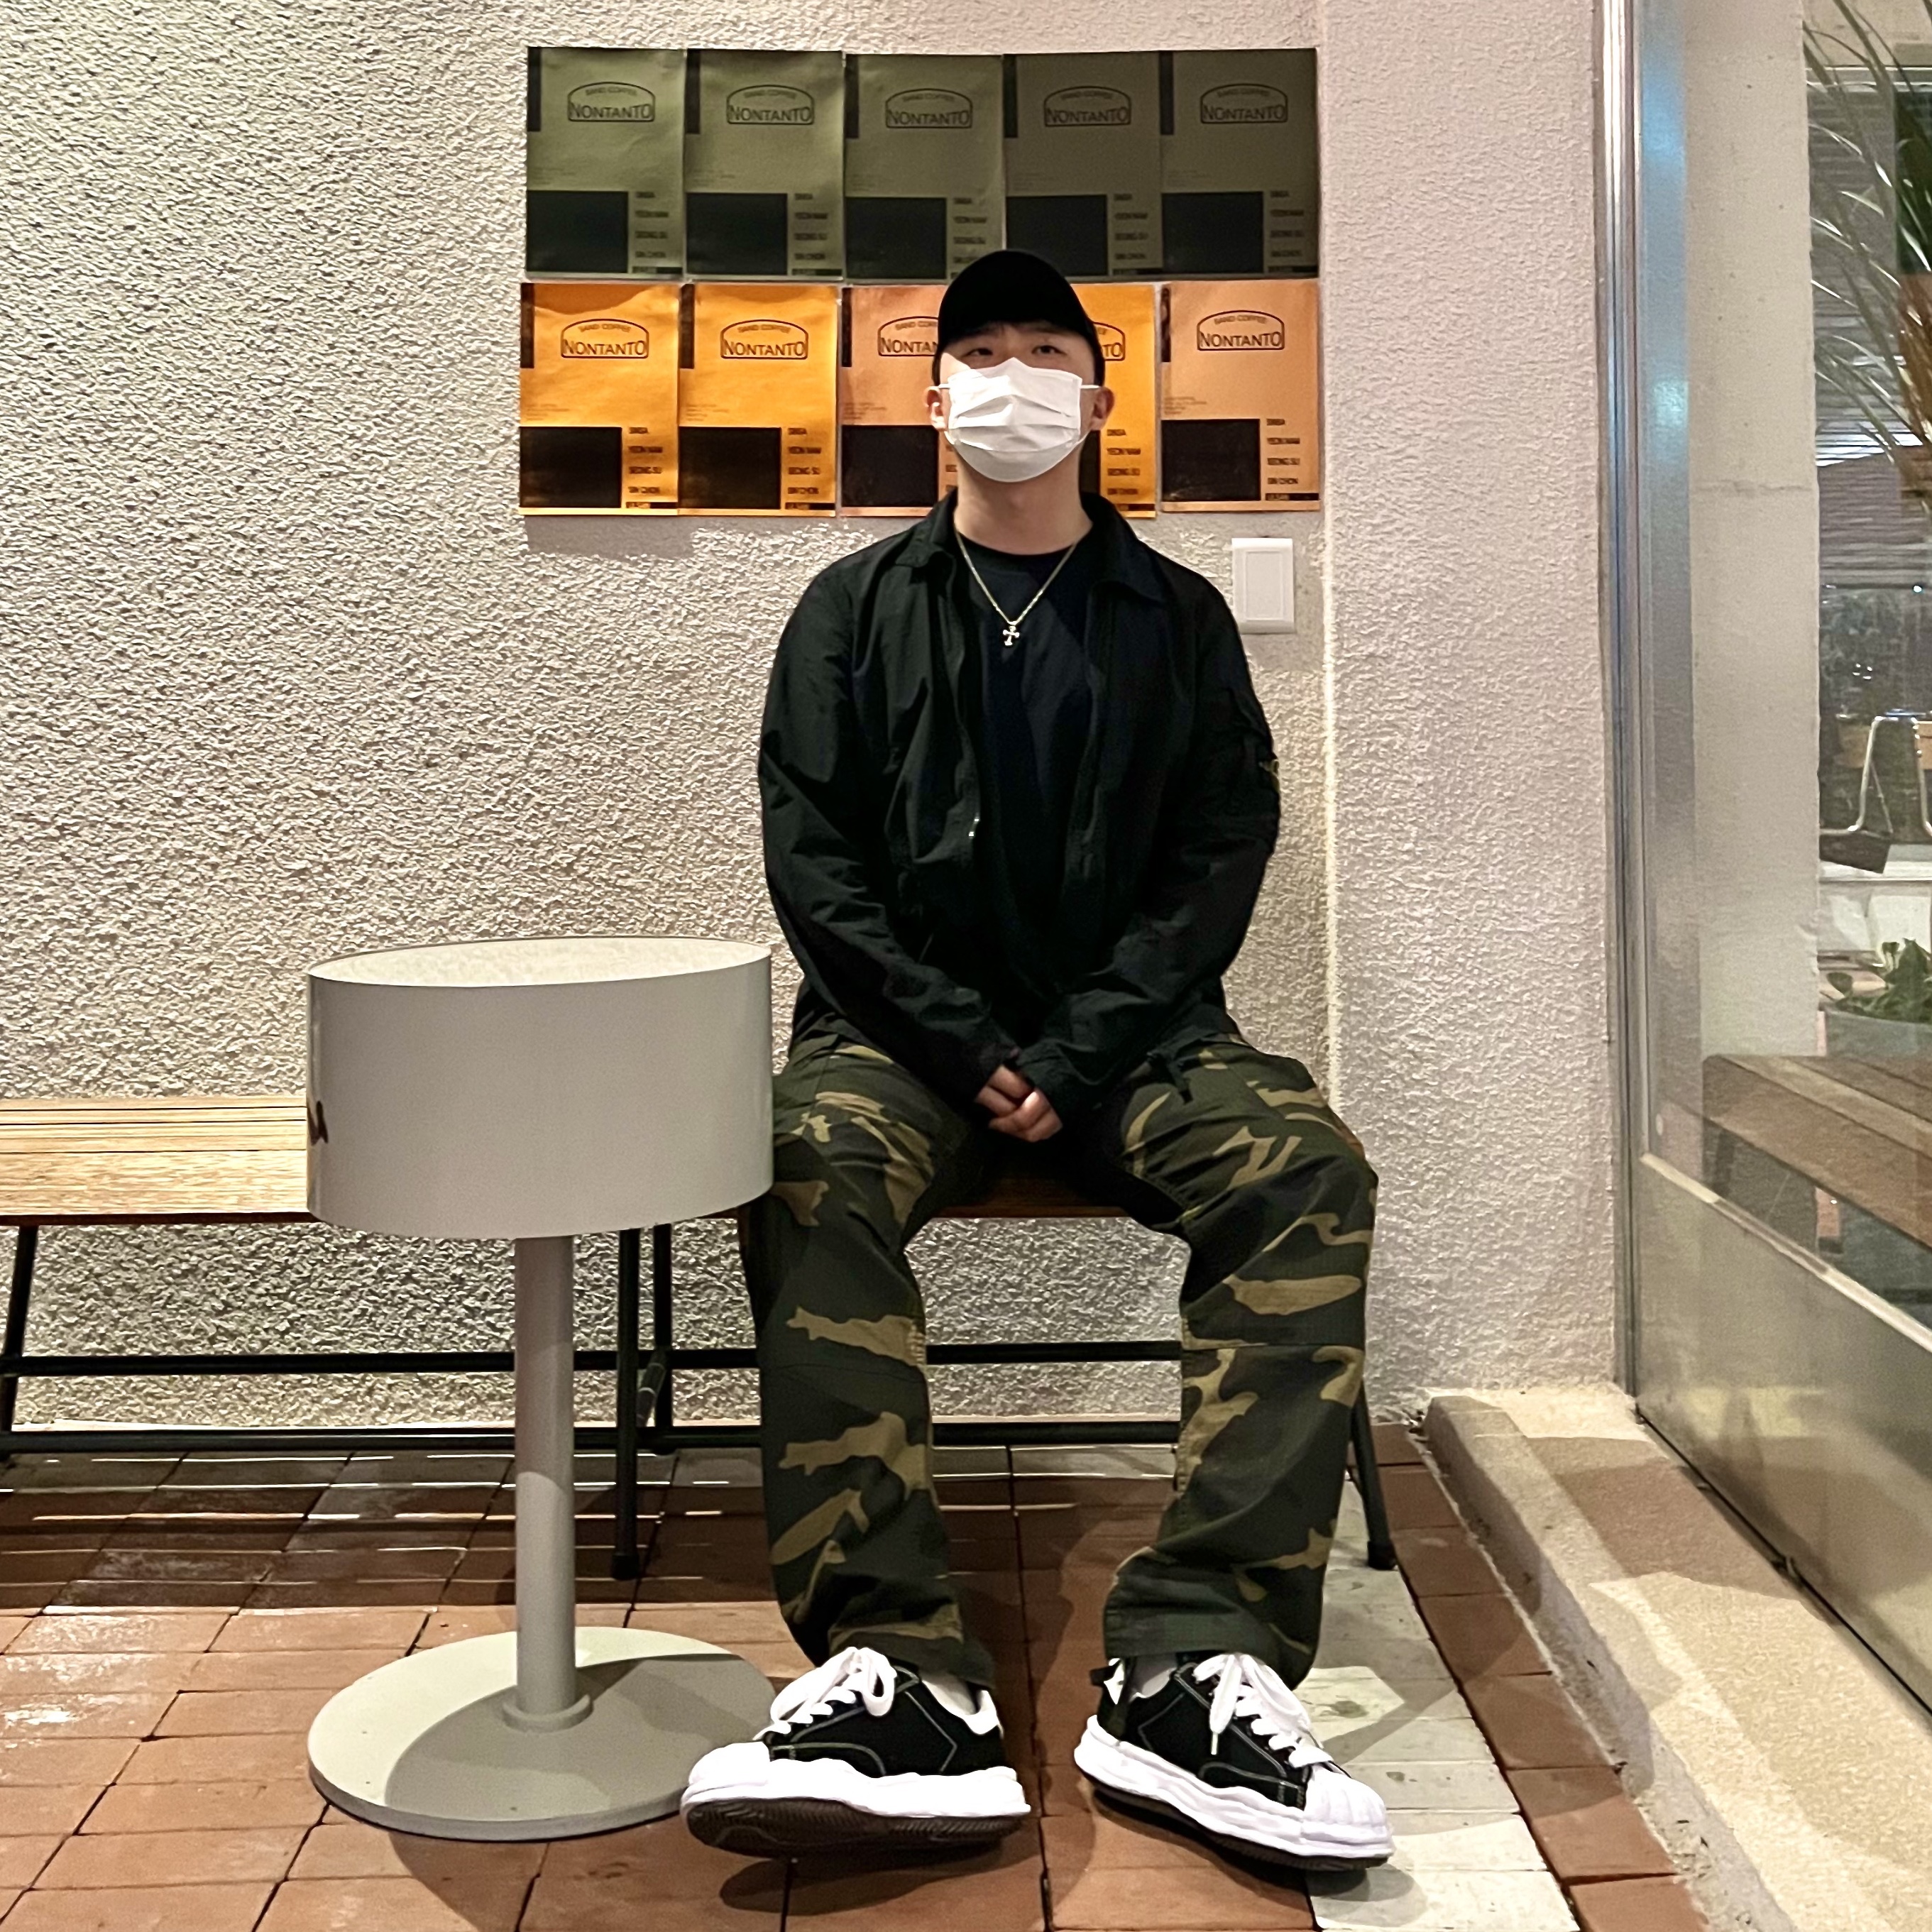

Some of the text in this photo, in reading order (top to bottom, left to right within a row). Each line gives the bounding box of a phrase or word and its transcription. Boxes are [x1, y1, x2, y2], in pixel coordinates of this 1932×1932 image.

[570, 102, 652, 118] NONTANTO
[729, 104, 811, 121] NONTANTO
[887, 109, 969, 126] NONTANTO
[1047, 107, 1129, 123] NONTANTO
[1203, 104, 1285, 120] NONTANTO
[880, 337, 938, 353] NONTAN
[1199, 331, 1281, 347] NONTANTO
[562, 339, 645, 356] NONTANTO
[723, 339, 805, 356] NONTANTO
